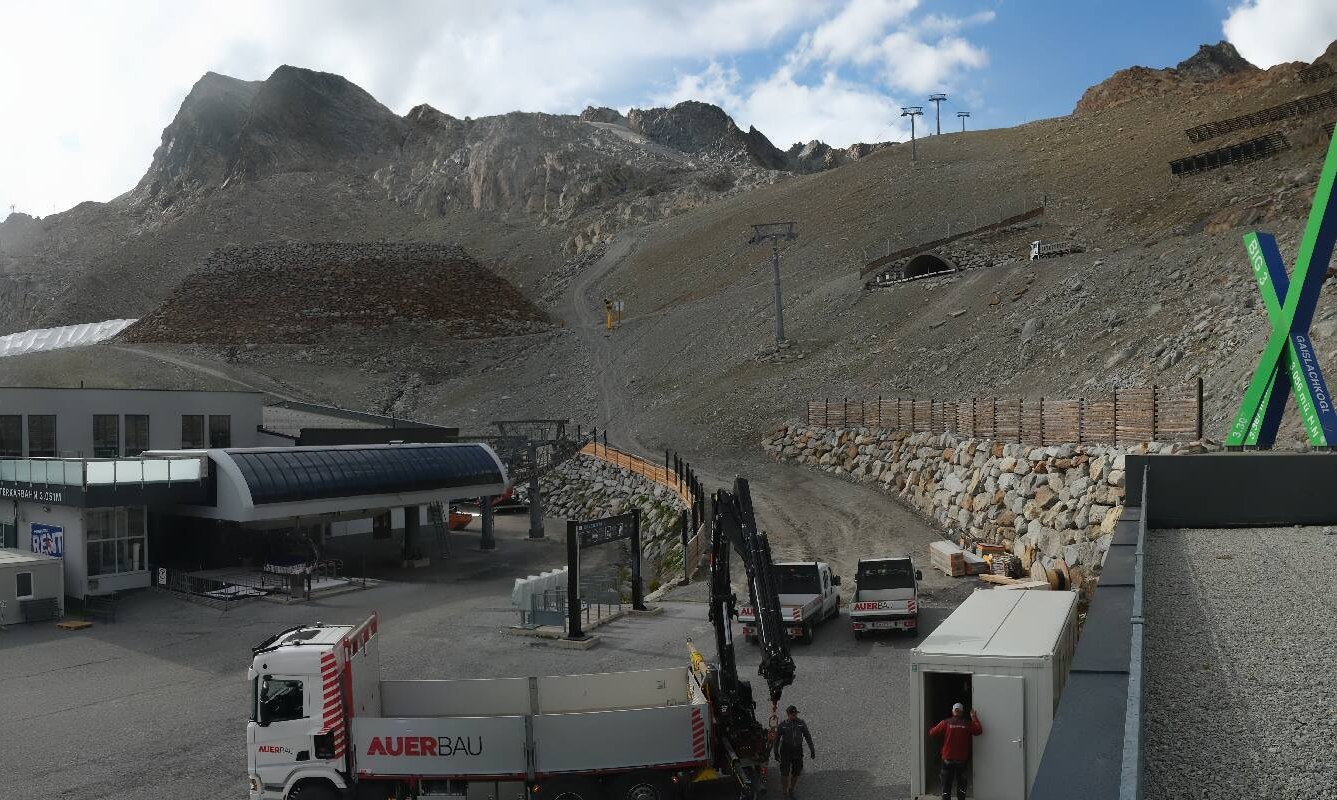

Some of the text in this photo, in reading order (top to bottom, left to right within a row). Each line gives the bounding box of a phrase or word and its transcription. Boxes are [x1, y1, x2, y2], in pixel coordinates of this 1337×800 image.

[1248, 239, 1268, 286] BIG 3
[1296, 335, 1330, 414] GAISLACHKOGL
[1232, 417, 1248, 438] 3.30
[32, 530, 63, 556] RENT
[366, 735, 483, 757] AUERBAU
